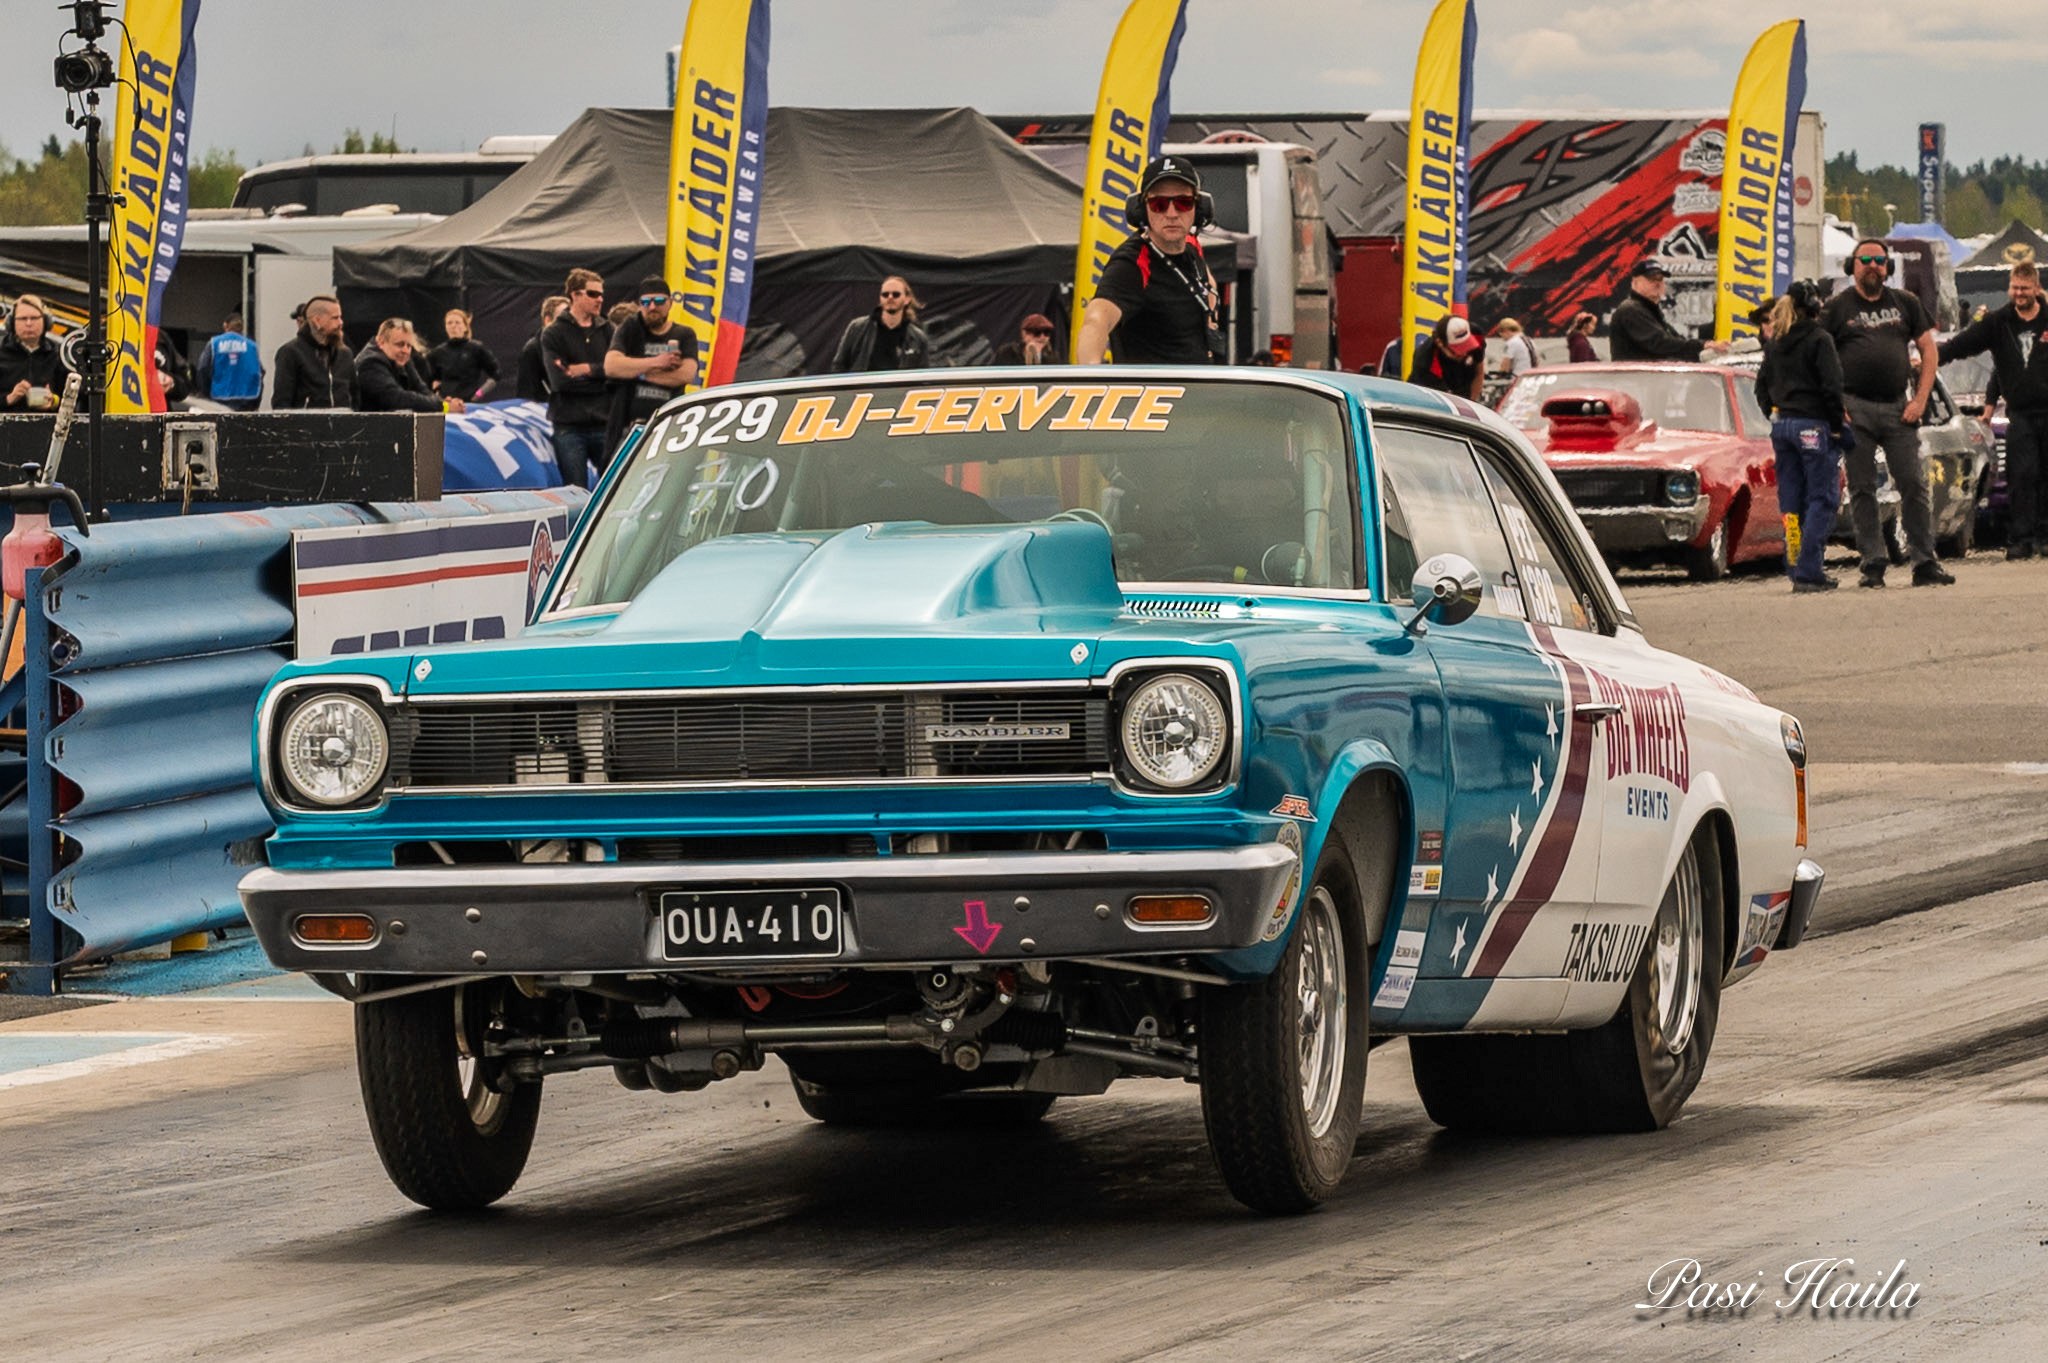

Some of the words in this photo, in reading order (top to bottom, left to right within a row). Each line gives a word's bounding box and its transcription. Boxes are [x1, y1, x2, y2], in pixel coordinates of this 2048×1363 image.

[115, 48, 173, 406] BLÅKLÄDER
[154, 107, 187, 284] WORKWEAR
[672, 78, 737, 388] ÅKLÄDER
[729, 129, 760, 285] WORKWEAR
[1409, 108, 1454, 348] LÅKLÄDER
[1776, 161, 1793, 276] WORKWEAR
[645, 396, 779, 461] 1329
[777, 385, 1187, 446] DJ-SERVICE
[931, 726, 1065, 739] RAMBLER
[1586, 665, 1632, 782] BIG
[1622, 681, 1690, 795] WHEELS
[1626, 786, 1669, 821] EVENTS
[667, 904, 834, 945] OUA-410
